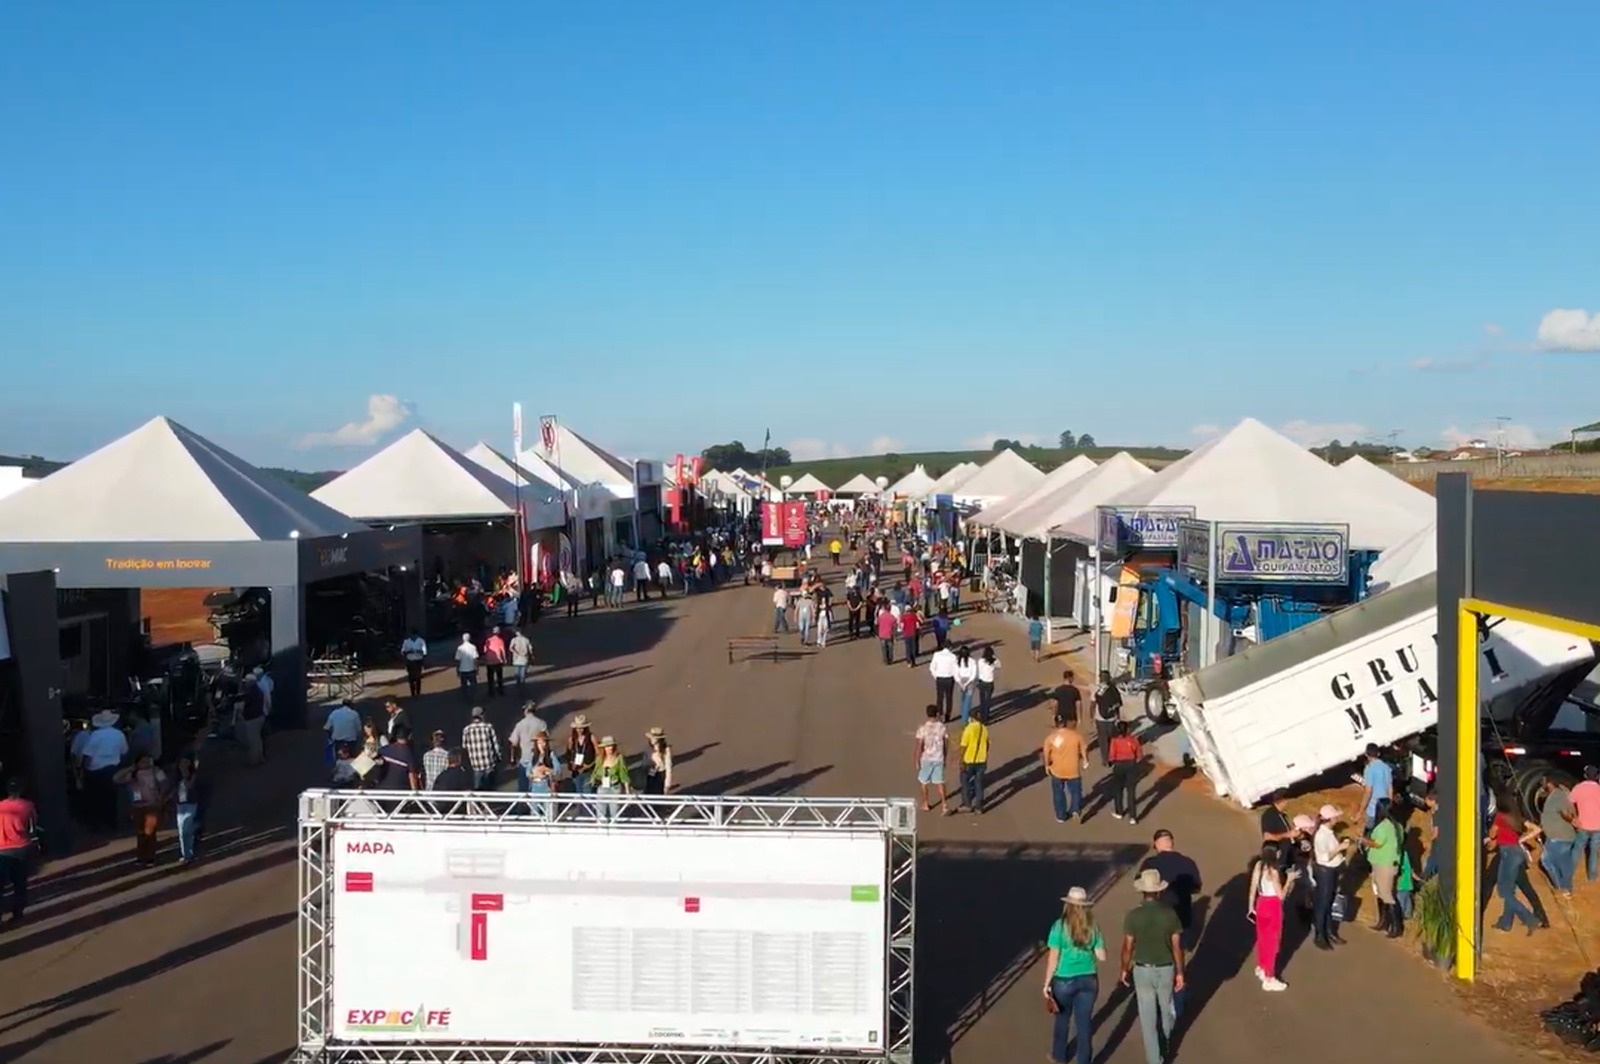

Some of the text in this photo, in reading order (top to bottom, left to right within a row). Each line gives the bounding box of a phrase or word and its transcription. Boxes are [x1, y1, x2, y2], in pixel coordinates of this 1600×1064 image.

[106, 558, 211, 570] Tradição em Inovar
[1256, 562, 1338, 573] EQUIPAMENTOS
[346, 842, 394, 854] MAPA
